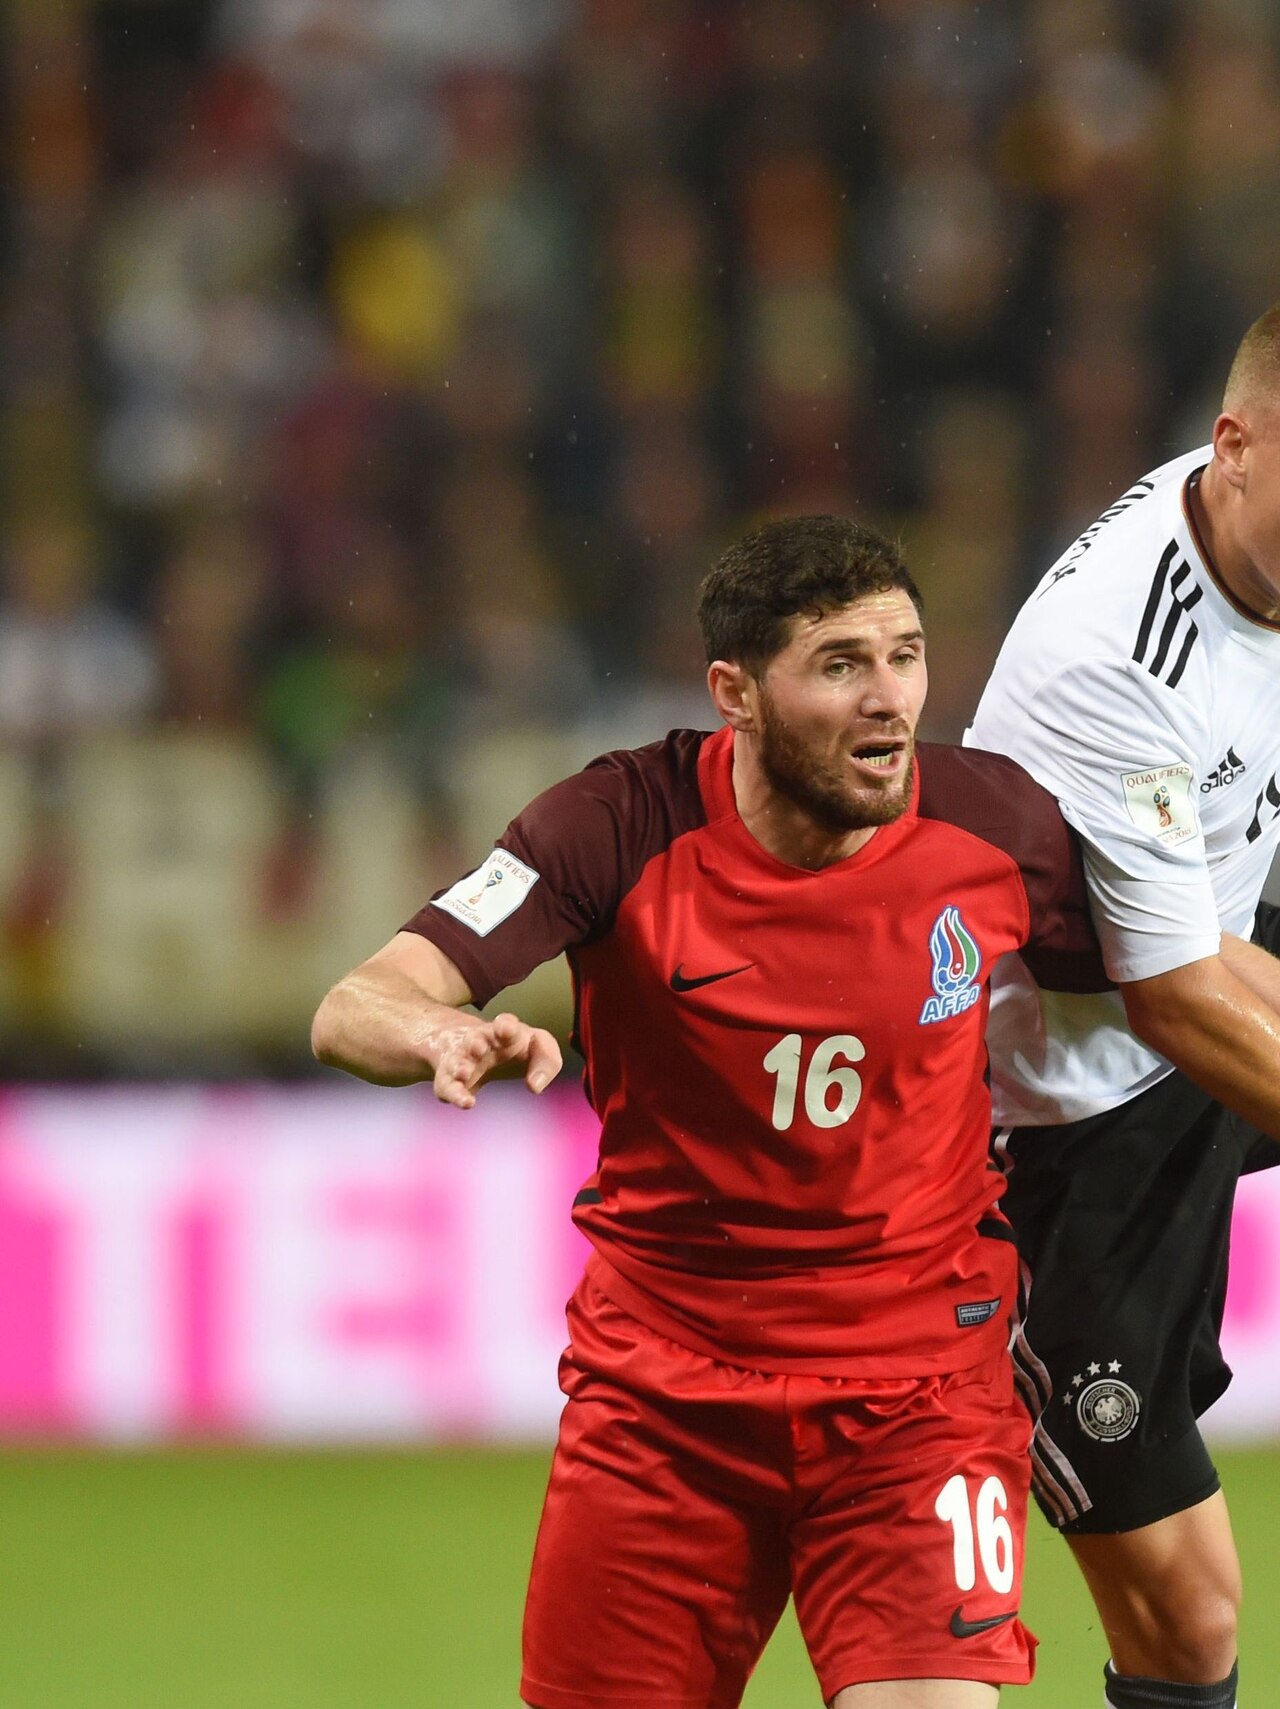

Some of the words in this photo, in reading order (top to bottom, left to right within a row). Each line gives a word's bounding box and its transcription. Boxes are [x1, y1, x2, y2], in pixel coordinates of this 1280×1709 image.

[919, 984, 982, 1025] AFFA
[762, 1033, 866, 1132] 16
[935, 1474, 1015, 1594] 16
